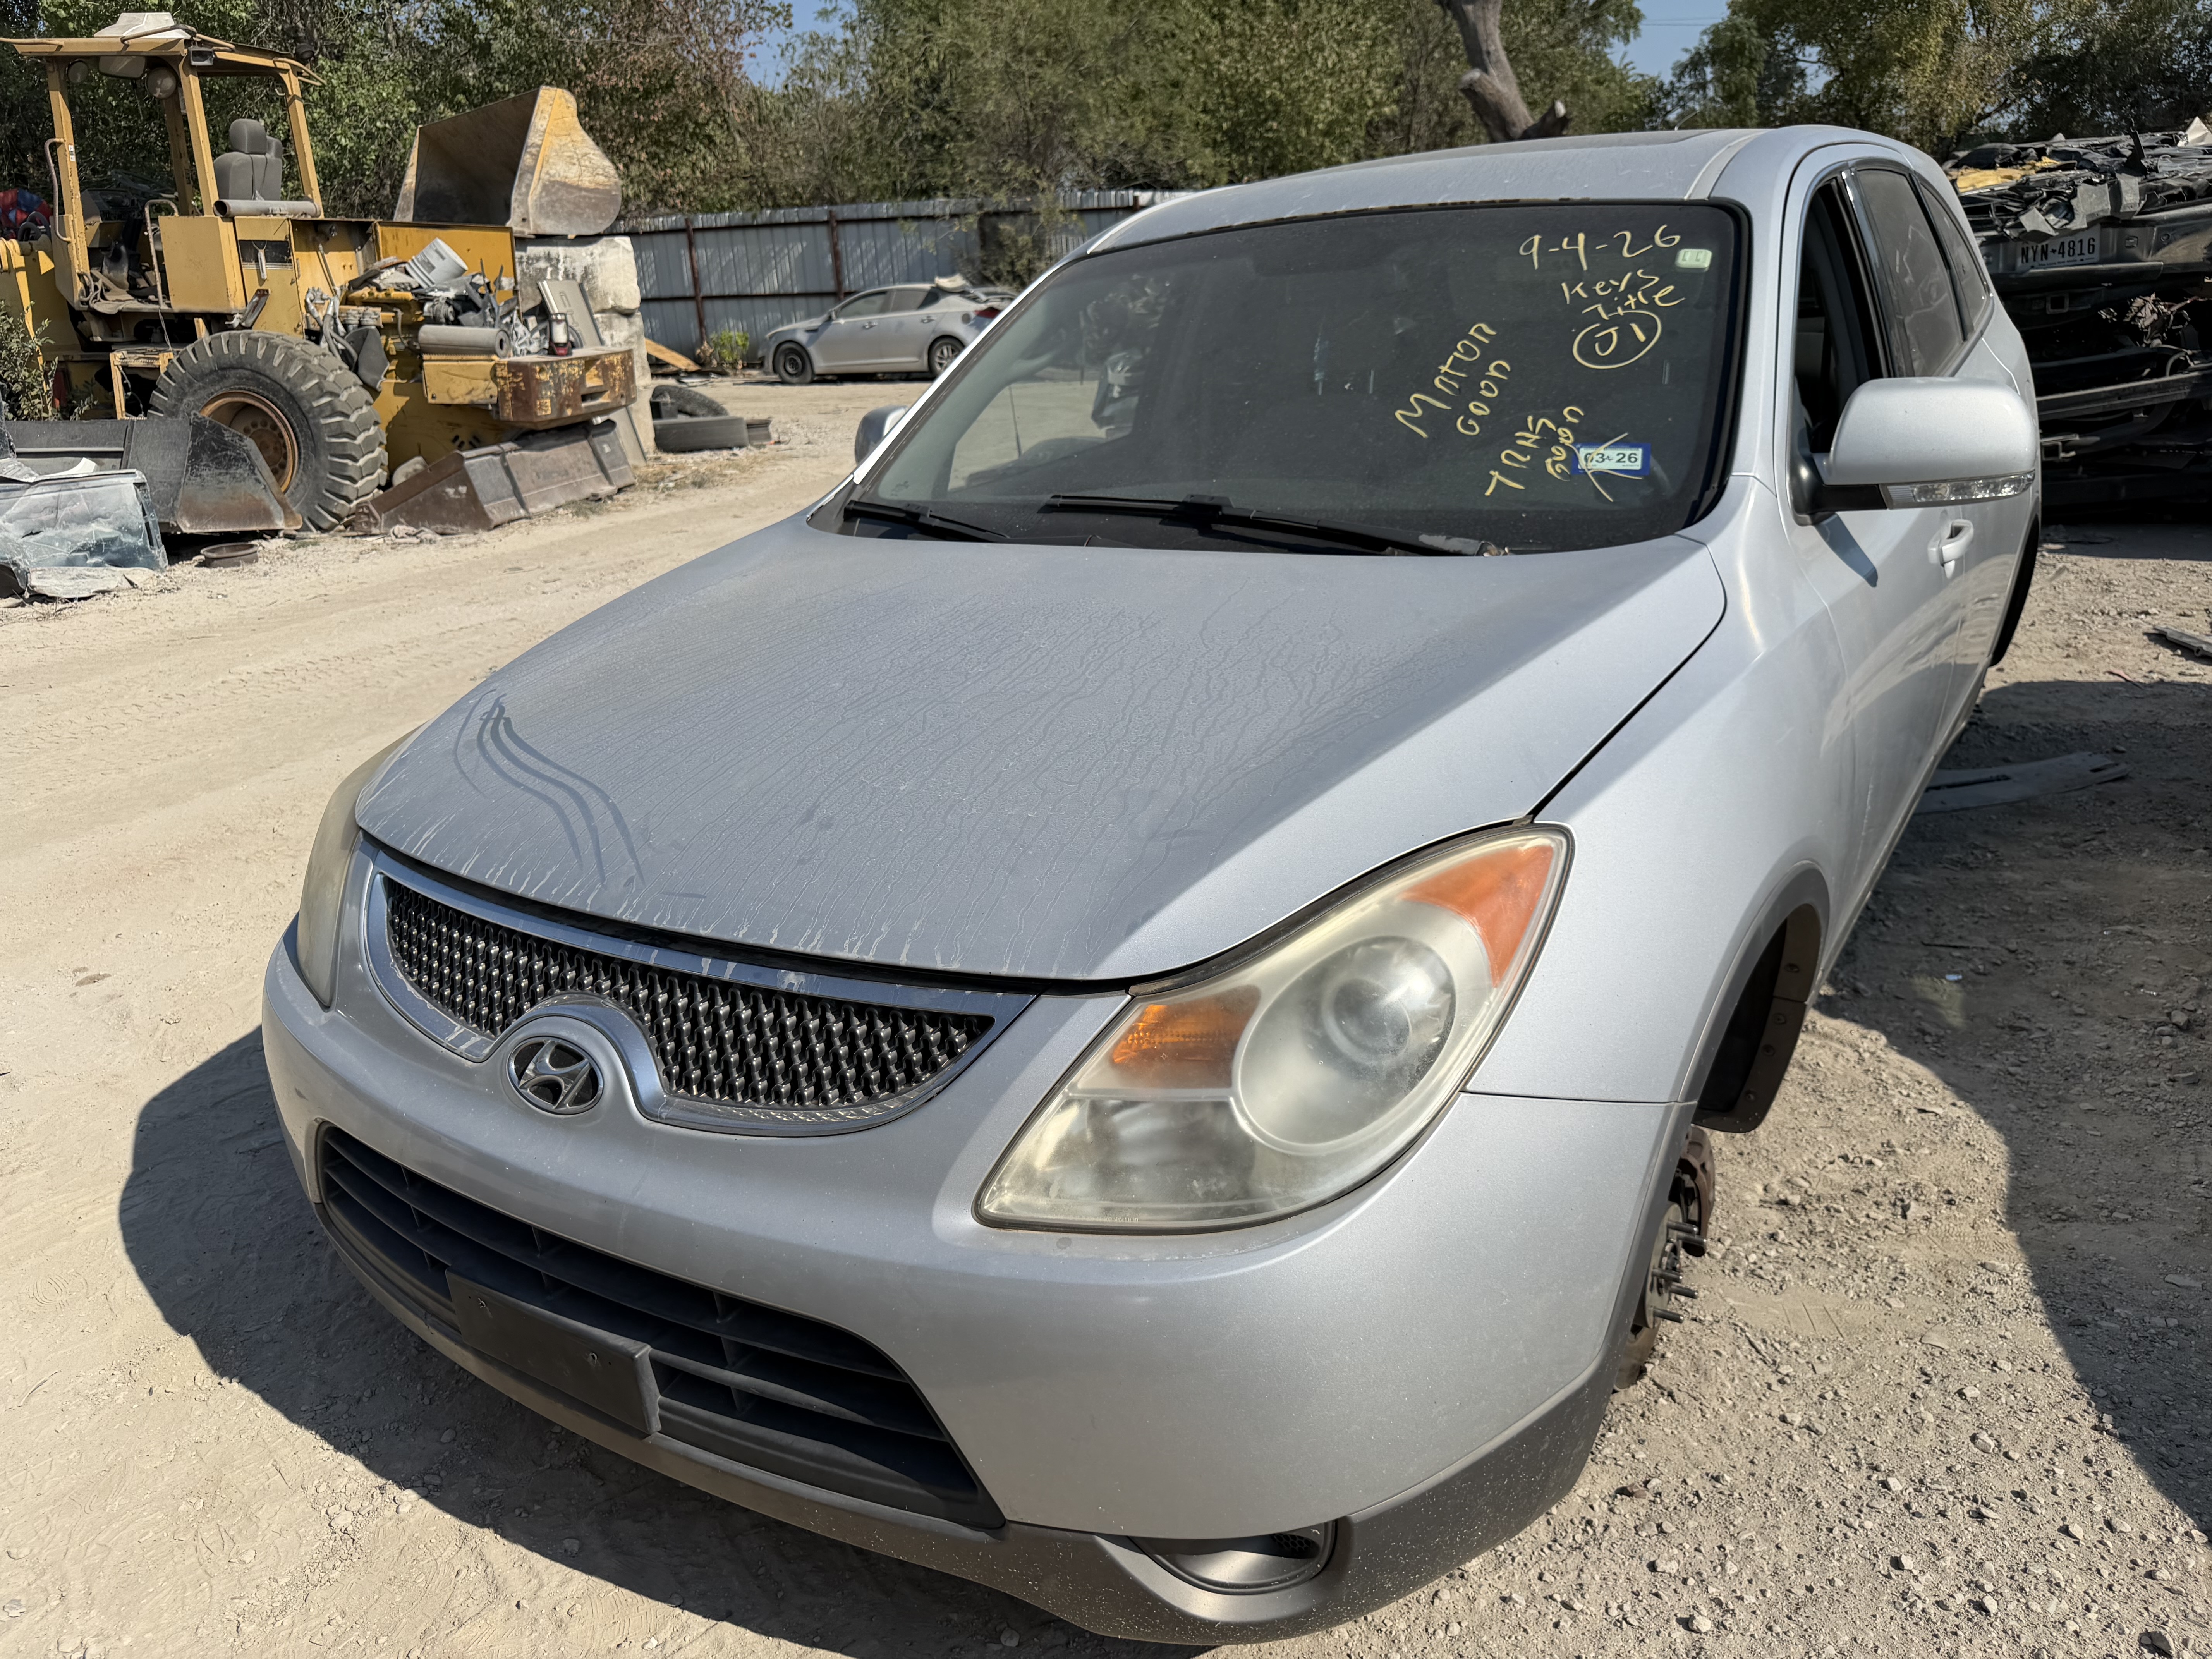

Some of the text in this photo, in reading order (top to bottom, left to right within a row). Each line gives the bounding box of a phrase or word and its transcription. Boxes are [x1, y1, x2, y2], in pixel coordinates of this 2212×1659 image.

[1519, 224, 1681, 271] 9-4-26
[2058, 237, 2095, 258] 4816
[1615, 452, 1638, 464] 26
